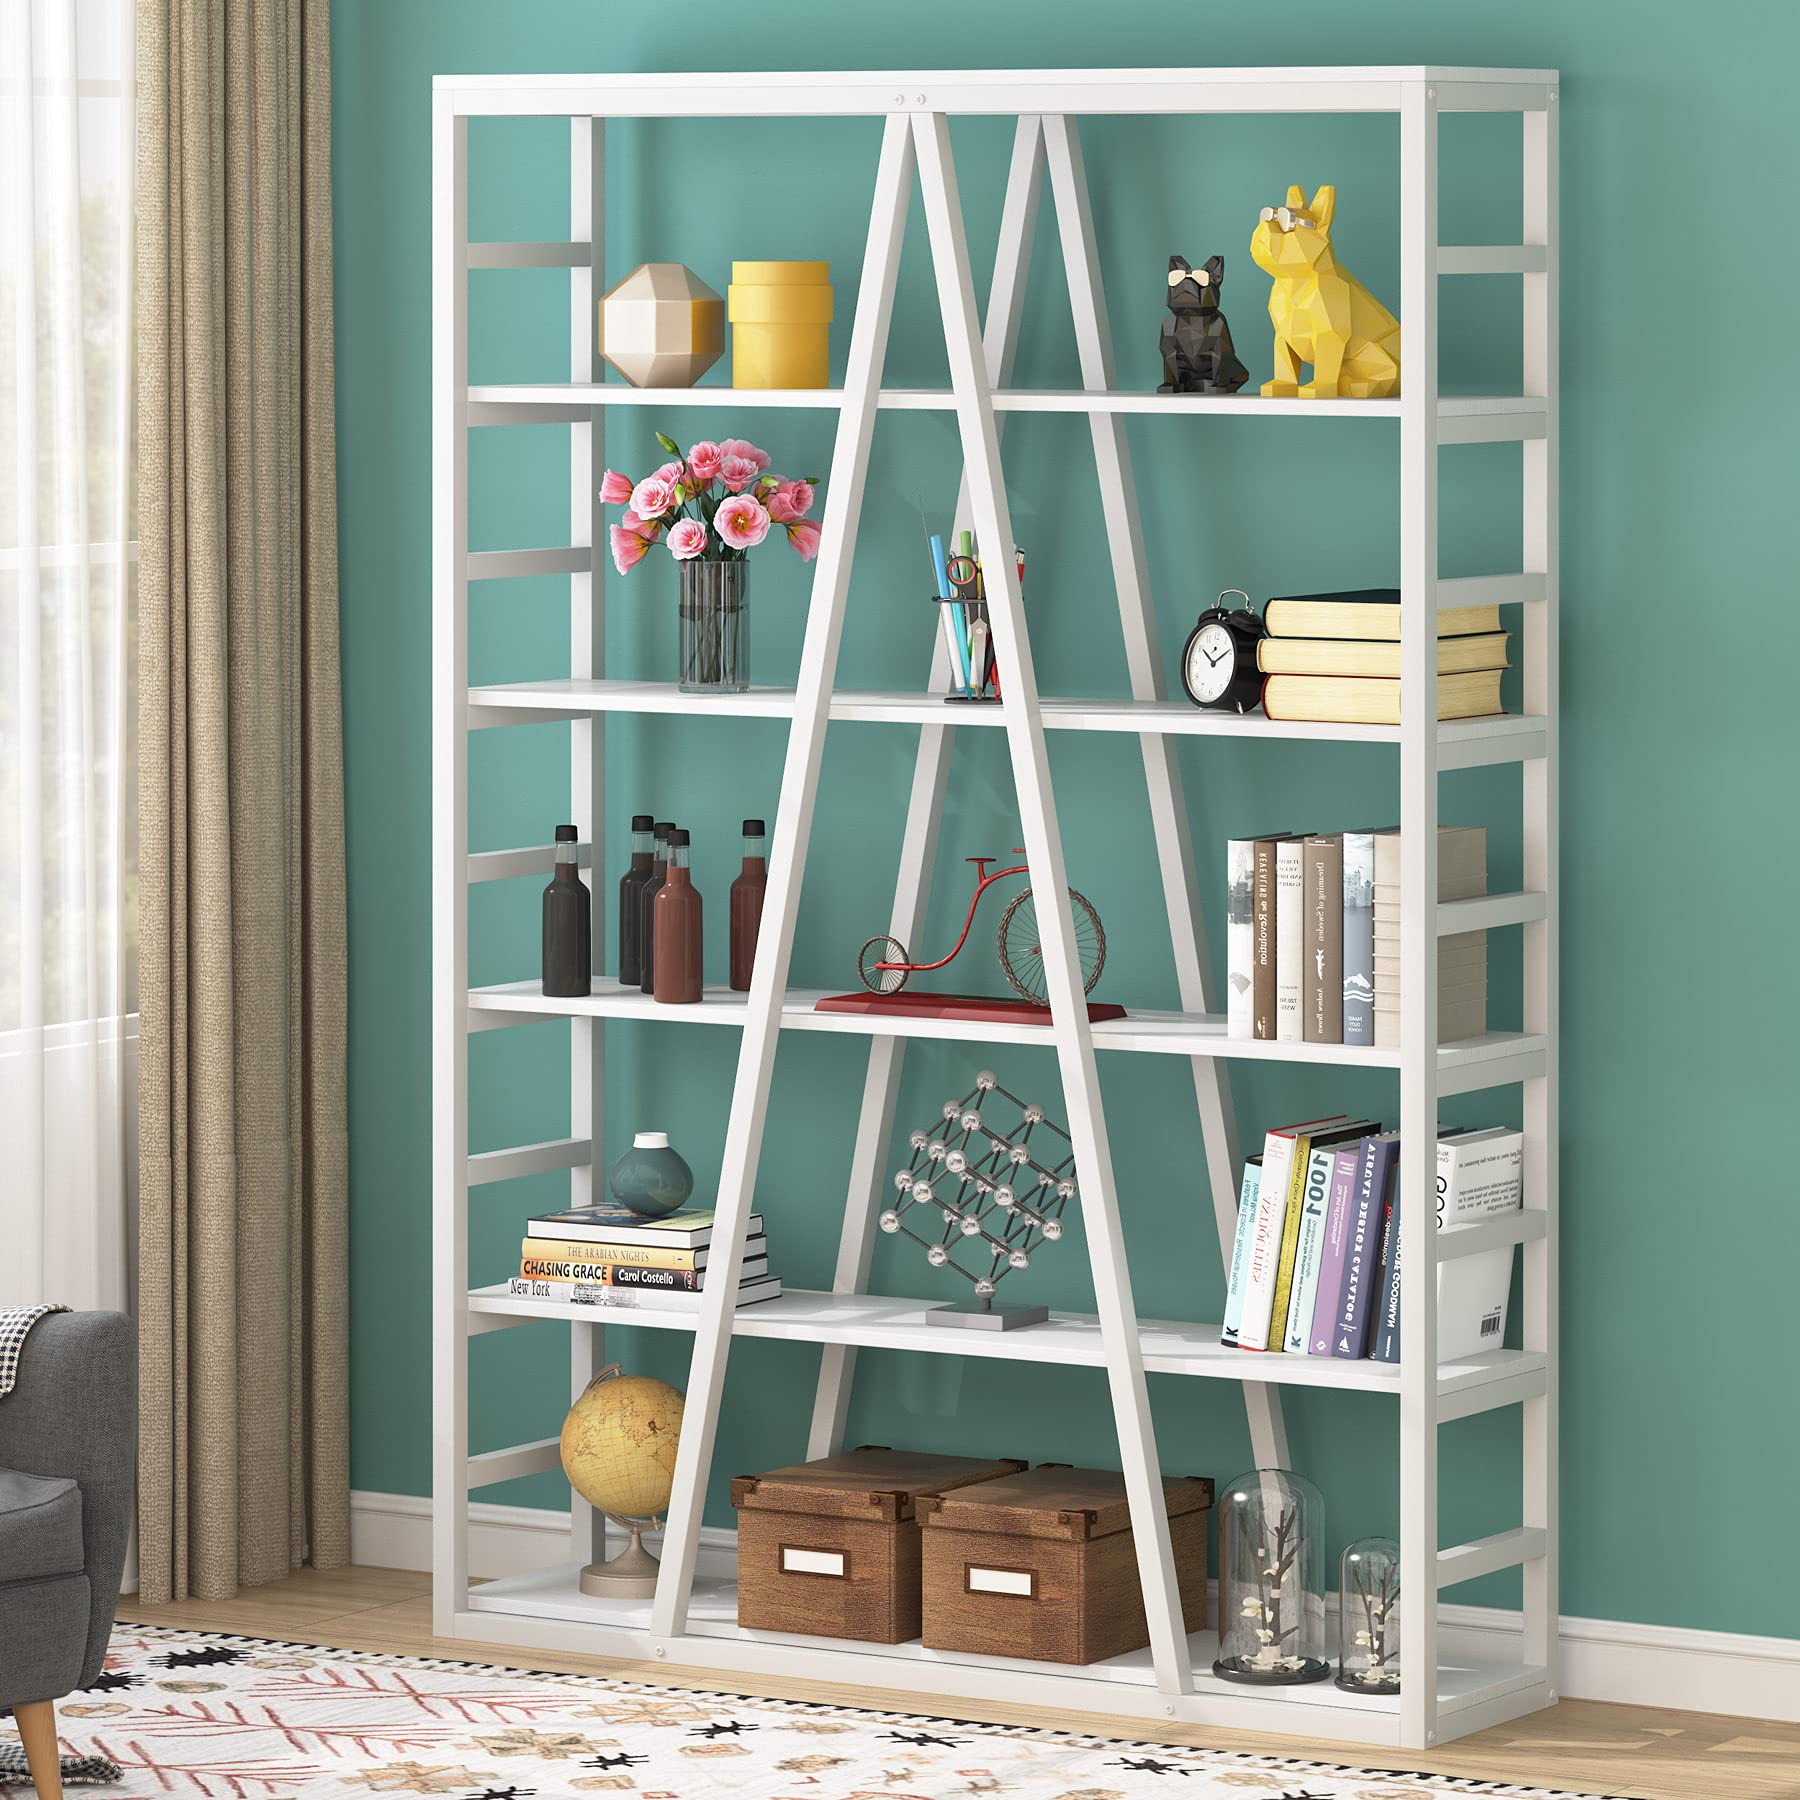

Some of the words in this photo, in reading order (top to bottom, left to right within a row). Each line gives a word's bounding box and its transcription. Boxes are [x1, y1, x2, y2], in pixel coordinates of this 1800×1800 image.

[568, 1246, 582, 1257] THE
[584, 1248, 618, 1260] ARABIAN
[621, 1250, 650, 1262] NIGHTS
[524, 1261, 570, 1277] CHASING
[573, 1263, 608, 1280] GRACE
[618, 1269, 640, 1282] Carol
[641, 1270, 673, 1285] Costello
[510, 1279, 528, 1294] New
[531, 1281, 550, 1297] York
